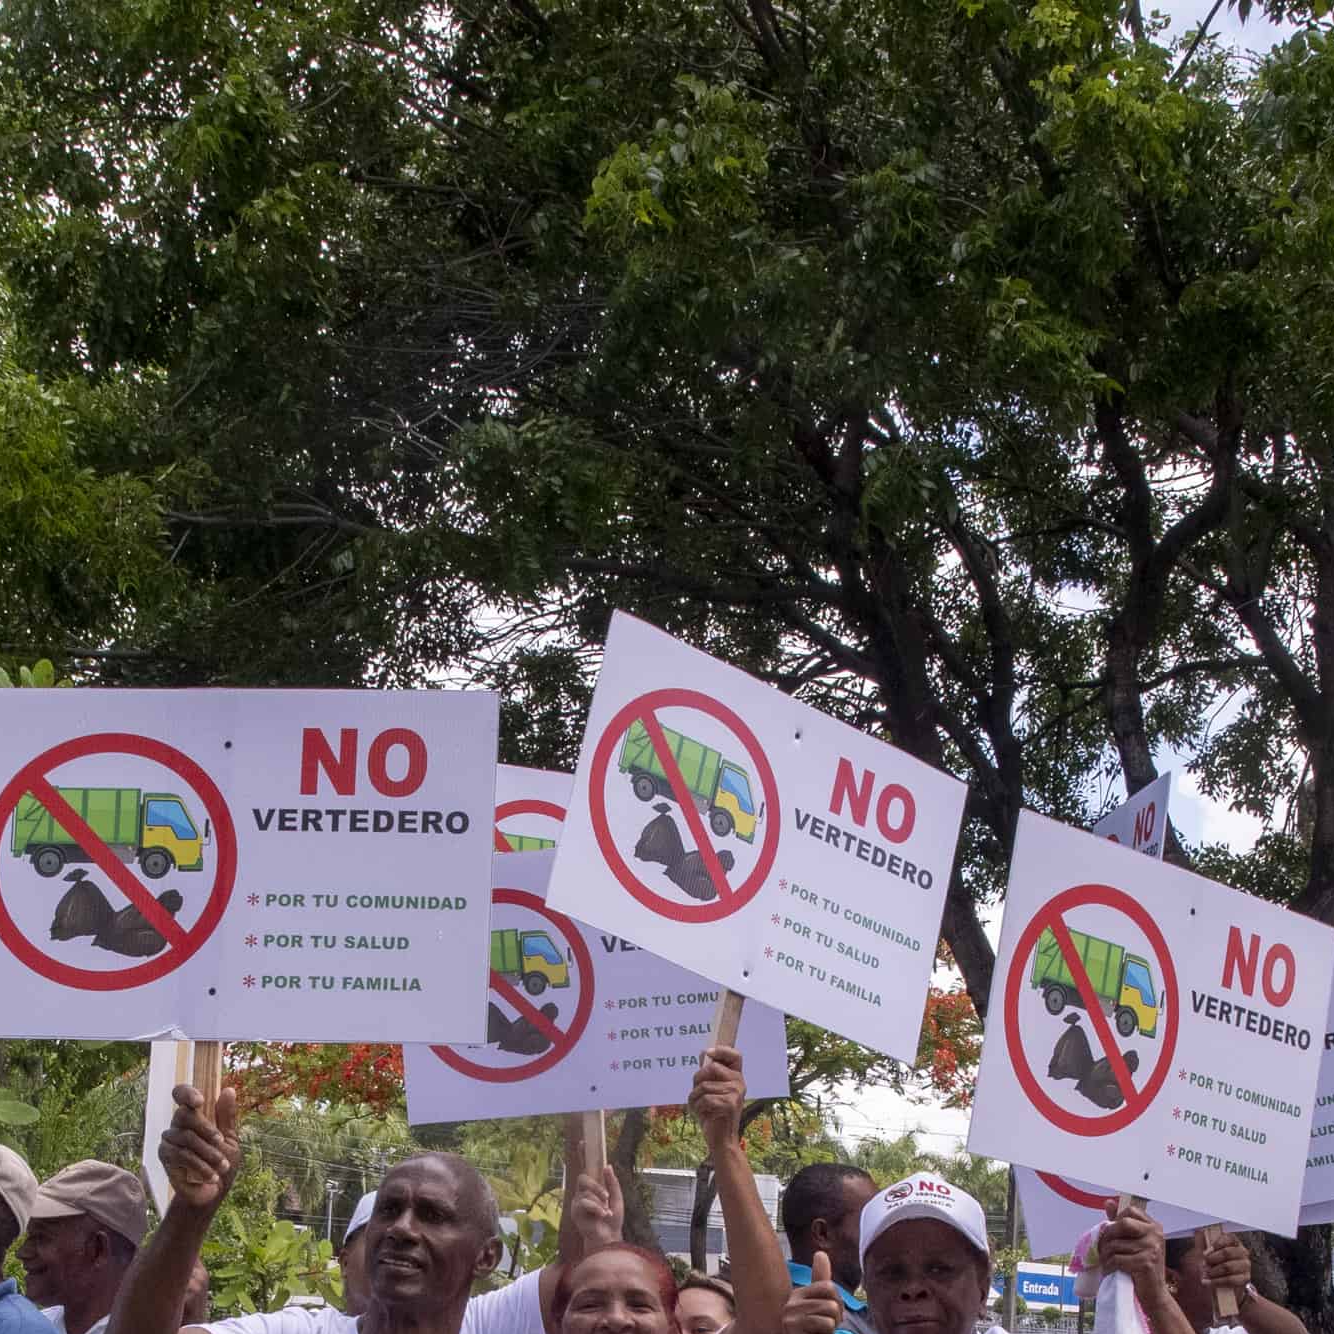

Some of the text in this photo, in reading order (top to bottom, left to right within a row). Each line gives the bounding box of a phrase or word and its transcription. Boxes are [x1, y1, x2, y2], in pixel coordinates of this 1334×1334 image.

[300, 728, 427, 797] NO
[828, 757, 916, 844] NO
[252, 808, 469, 834] VERTEDERO
[1133, 801, 1155, 850] NO
[794, 808, 933, 890] VERTEDERO
[266, 894, 467, 910] POR TU COMUNIDAD
[790, 884, 921, 952] POR TU COMUNIDAD
[263, 935, 410, 950] POR TU SALUD
[783, 918, 880, 969] POR TU SALUD
[261, 975, 422, 991] POR TU FAMILIA
[776, 951, 882, 1007] POR TU FAMILIA
[1221, 925, 1296, 1007] NO
[618, 997, 648, 1009] POR
[652, 995, 672, 1007] TU
[1191, 990, 1311, 1050] VERTEDERO
[621, 1023, 712, 1040] POR TU SAL
[622, 1059, 652, 1070] POR
[656, 1056, 676, 1068] TU
[1189, 1072, 1302, 1118] POR TU COMUNIDAD
[1184, 1110, 1267, 1145] POR TU SALUD
[1178, 1147, 1269, 1184] POR TU FAMILIA
[919, 1180, 950, 1195] NO
[1023, 1280, 1059, 1296] Entrada
